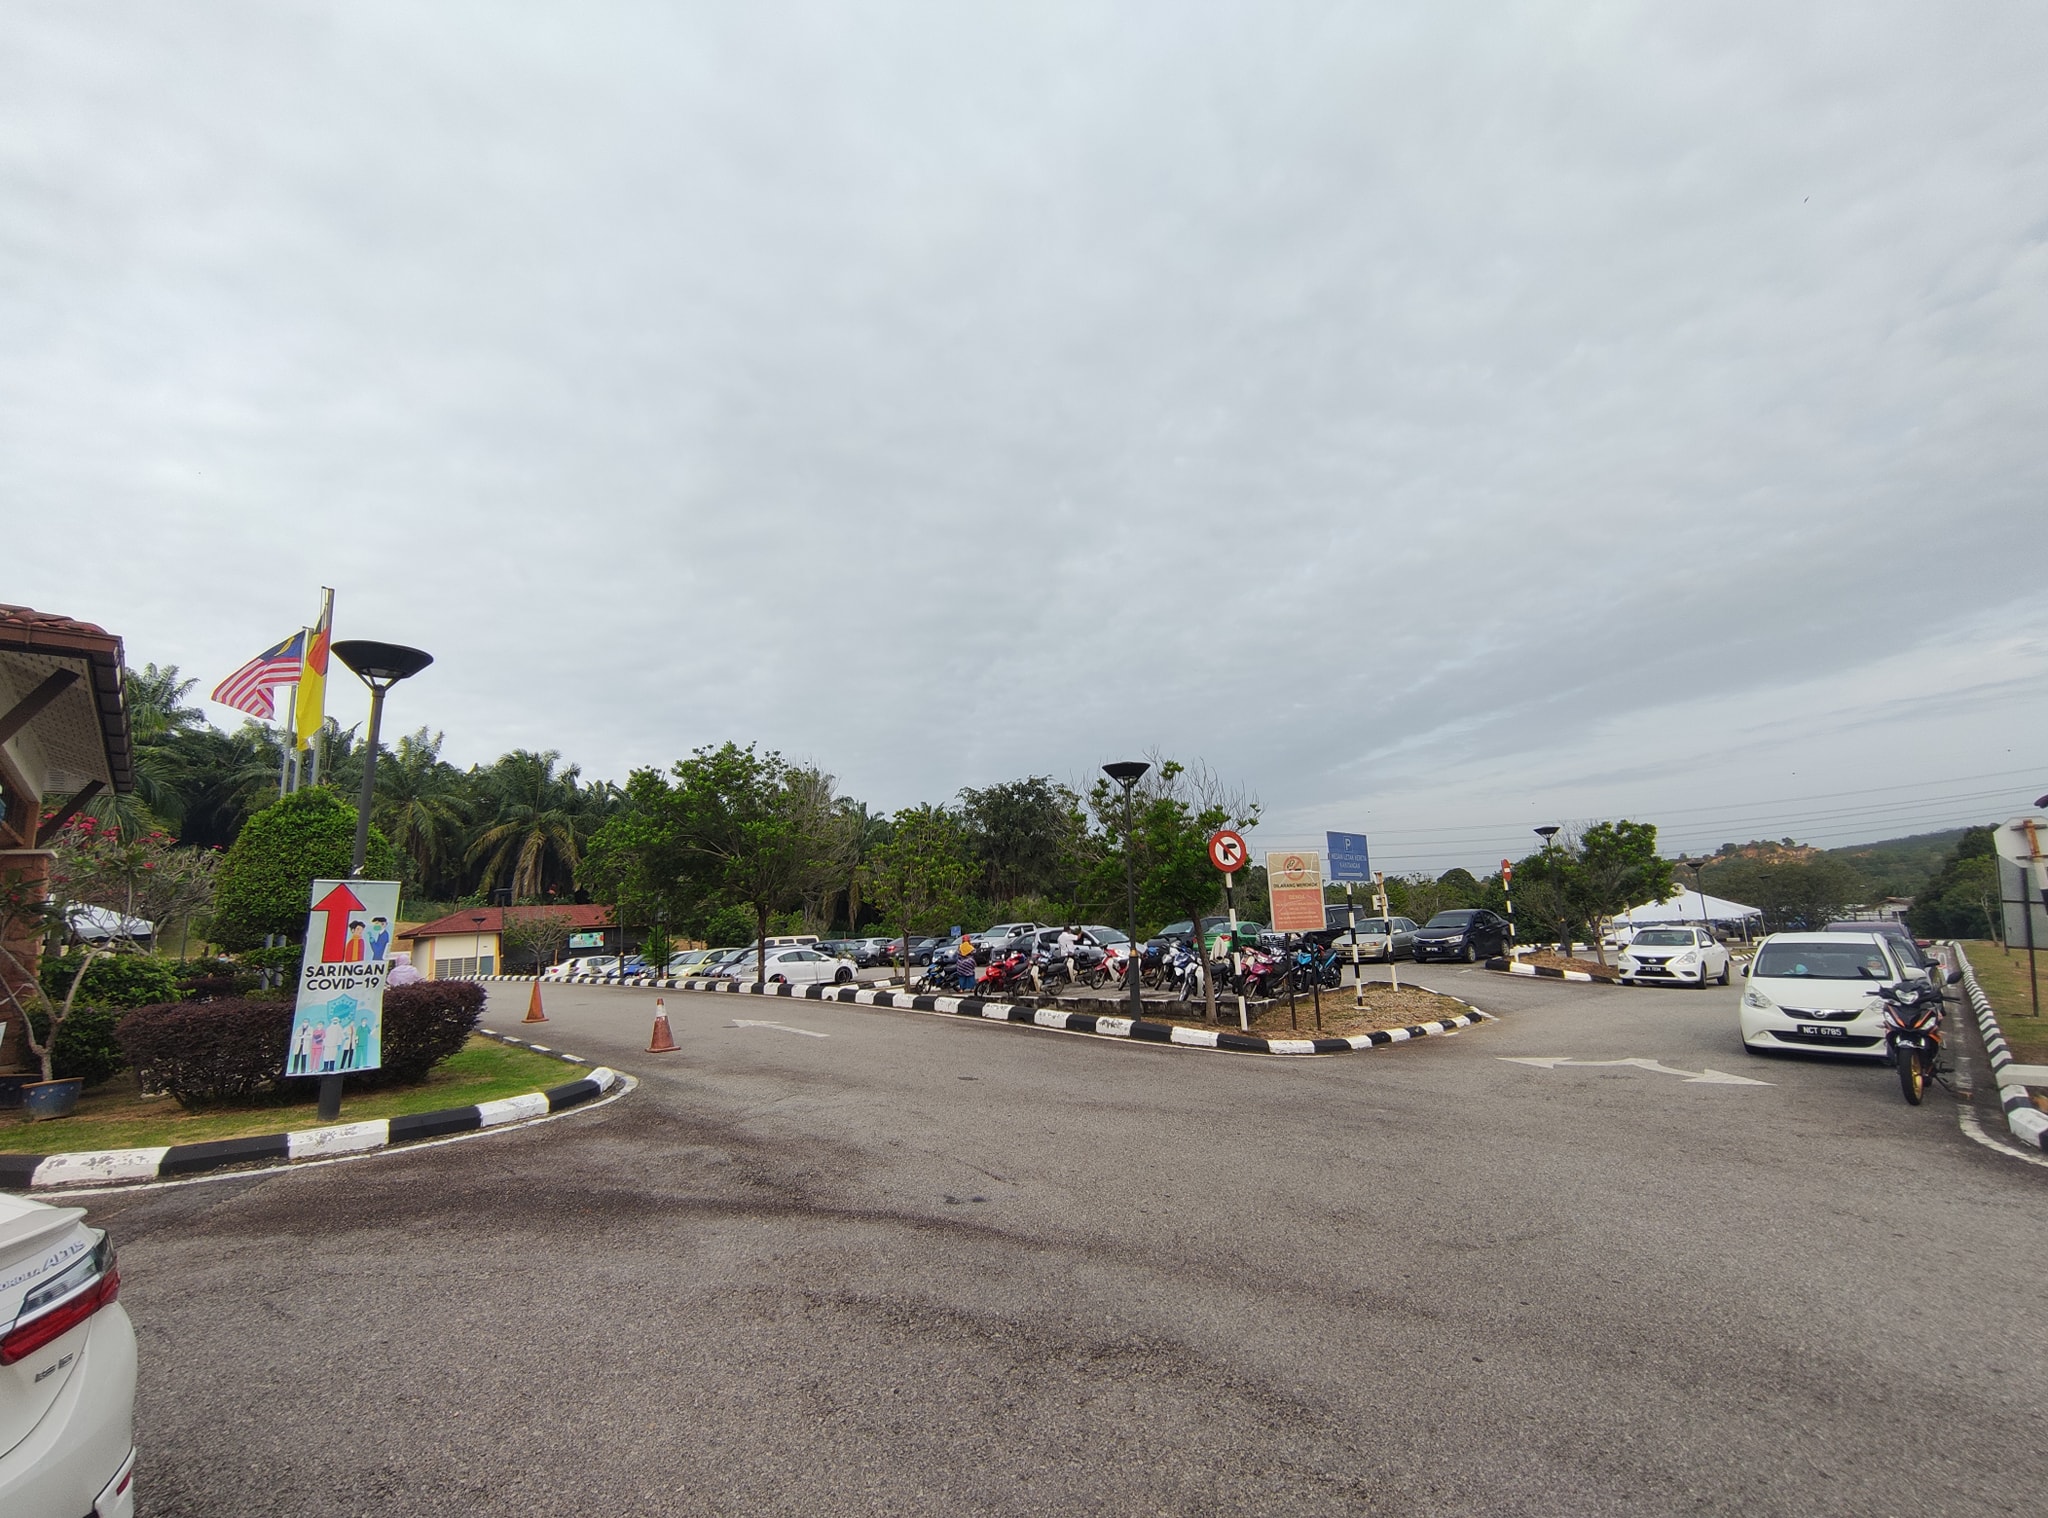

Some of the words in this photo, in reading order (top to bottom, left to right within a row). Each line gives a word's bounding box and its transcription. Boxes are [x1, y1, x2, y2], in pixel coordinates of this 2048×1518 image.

[1345, 838, 1351, 850] P
[305, 964, 385, 978] SARINGAN
[306, 977, 380, 991] COVID-19
[1802, 1026, 1818, 1035] NCT
[1820, 1027, 1842, 1036] 6785
[0, 1268, 42, 1292] OROLLA
